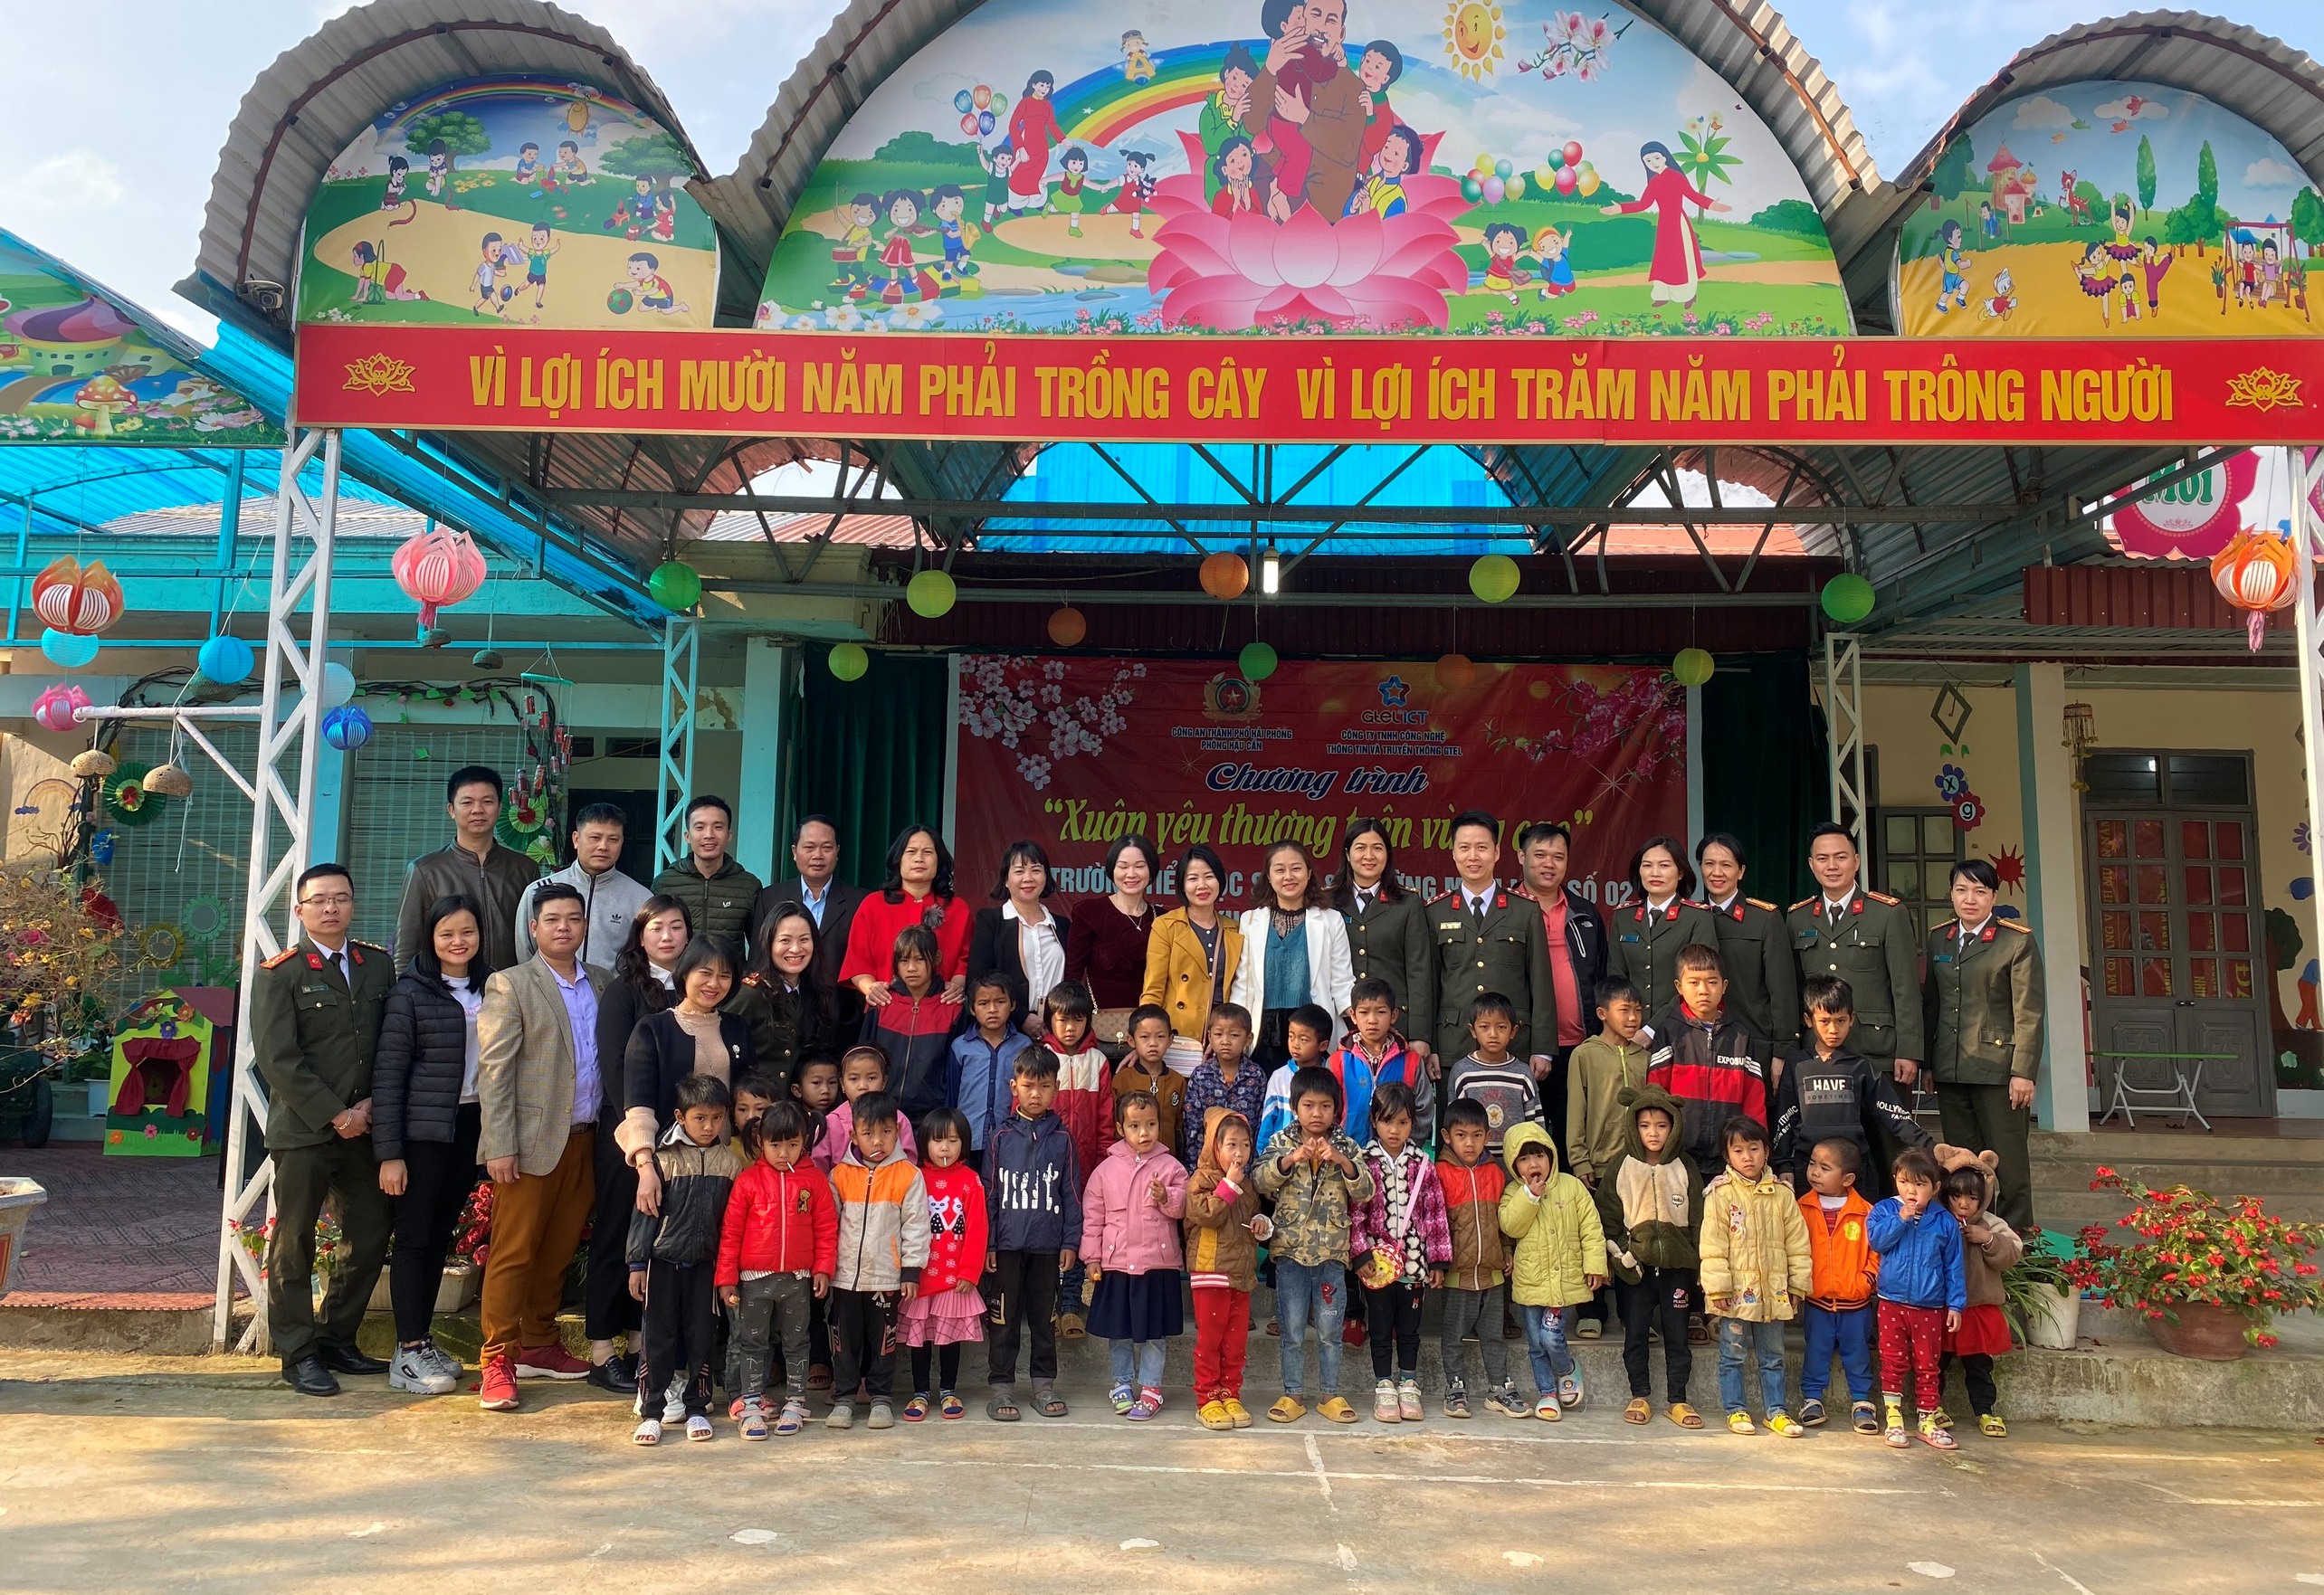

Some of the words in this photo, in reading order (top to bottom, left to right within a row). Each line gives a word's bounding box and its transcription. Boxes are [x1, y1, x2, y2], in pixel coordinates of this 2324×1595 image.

[471, 347, 506, 407] VÌ
[521, 354, 581, 420] LỢI
[595, 348, 663, 410] ÍCH
[681, 349, 786, 413] MƯỜI
[804, 349, 902, 415] NĂM
[919, 341, 1017, 418] PHẢI
[1035, 349, 1170, 420] TRỒNG
[1188, 356, 1268, 420] CÂY
[1298, 357, 1335, 420] VÌ
[1352, 361, 1412, 431] LỢI
[1428, 357, 1495, 421] ÍCH
[1511, 355, 1636, 421] TRĂM
[1651, 355, 1750, 422] NĂM
[1767, 343, 1867, 422] PHẢI
[1883, 353, 2025, 422] TRÔNG
[2041, 357, 2173, 422] NGƯỜI
[1172, 726, 1193, 737] CÔNG
[1194, 727, 1206, 737] AN
[1207, 726, 1233, 739] THÀNH
[1341, 728, 1364, 740] CÔNG
[1365, 730, 1376, 740] TY
[1376, 730, 1398, 741] TNHH
[1399, 730, 1422, 741] CÔNG
[1327, 743, 1353, 755] THÔNG
[1355, 745, 1368, 755] TIN
[1369, 743, 1381, 755] VÀ
[1414, 745, 1443, 756] THÔNG
[1443, 745, 1463, 756] GTEL
[1205, 763, 1338, 801] Chương
[1344, 765, 1429, 794] trình
[1156, 799, 1211, 855] yêu
[1217, 802, 1337, 859] thương
[1347, 803, 1412, 849] tên
[1605, 880, 1633, 906] 02
[1717, 1055, 1745, 1066] EXPOSU
